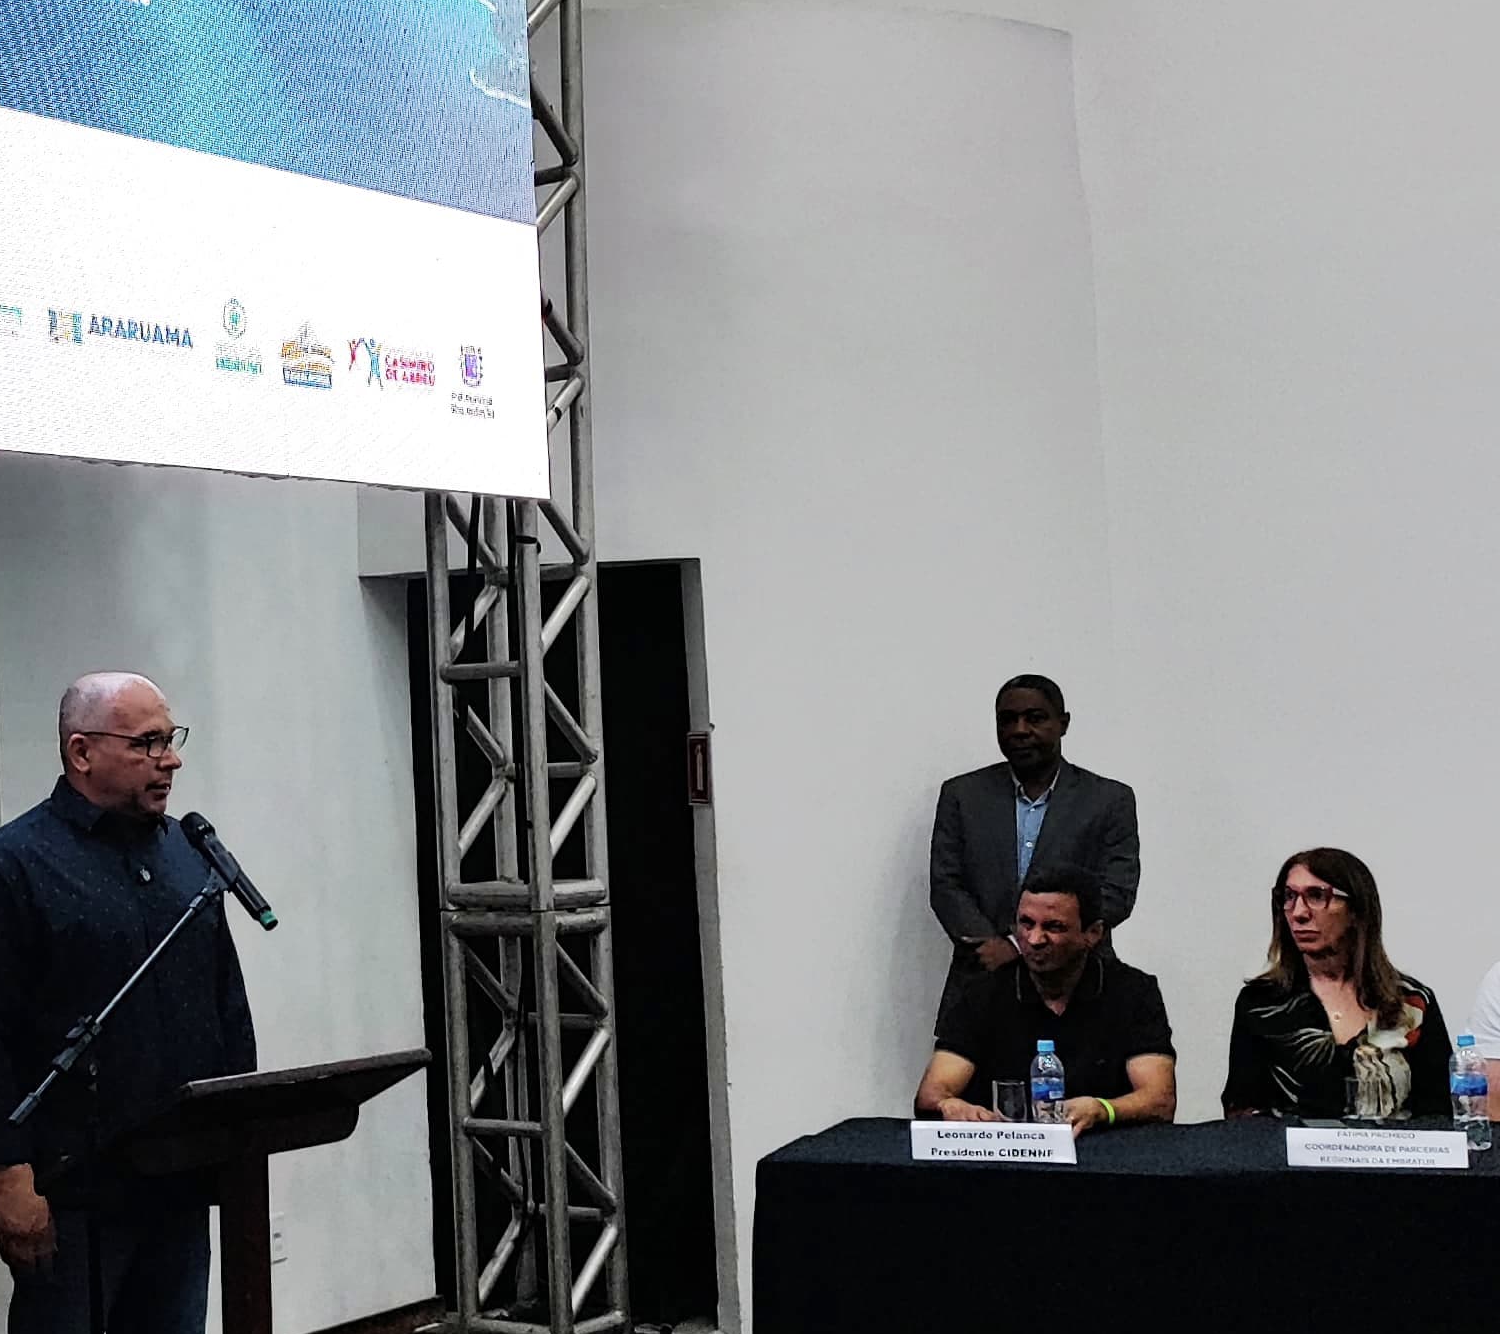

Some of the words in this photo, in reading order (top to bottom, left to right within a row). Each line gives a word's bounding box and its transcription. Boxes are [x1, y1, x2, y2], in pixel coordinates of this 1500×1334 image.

[89, 313, 194, 348] ARARUAMA
[937, 1130, 993, 1139] Leonardo
[931, 1147, 995, 1157] Presidente
[1305, 1143, 1382, 1153] COORDENADORA
[1399, 1146, 1450, 1154] PARCERIAS
